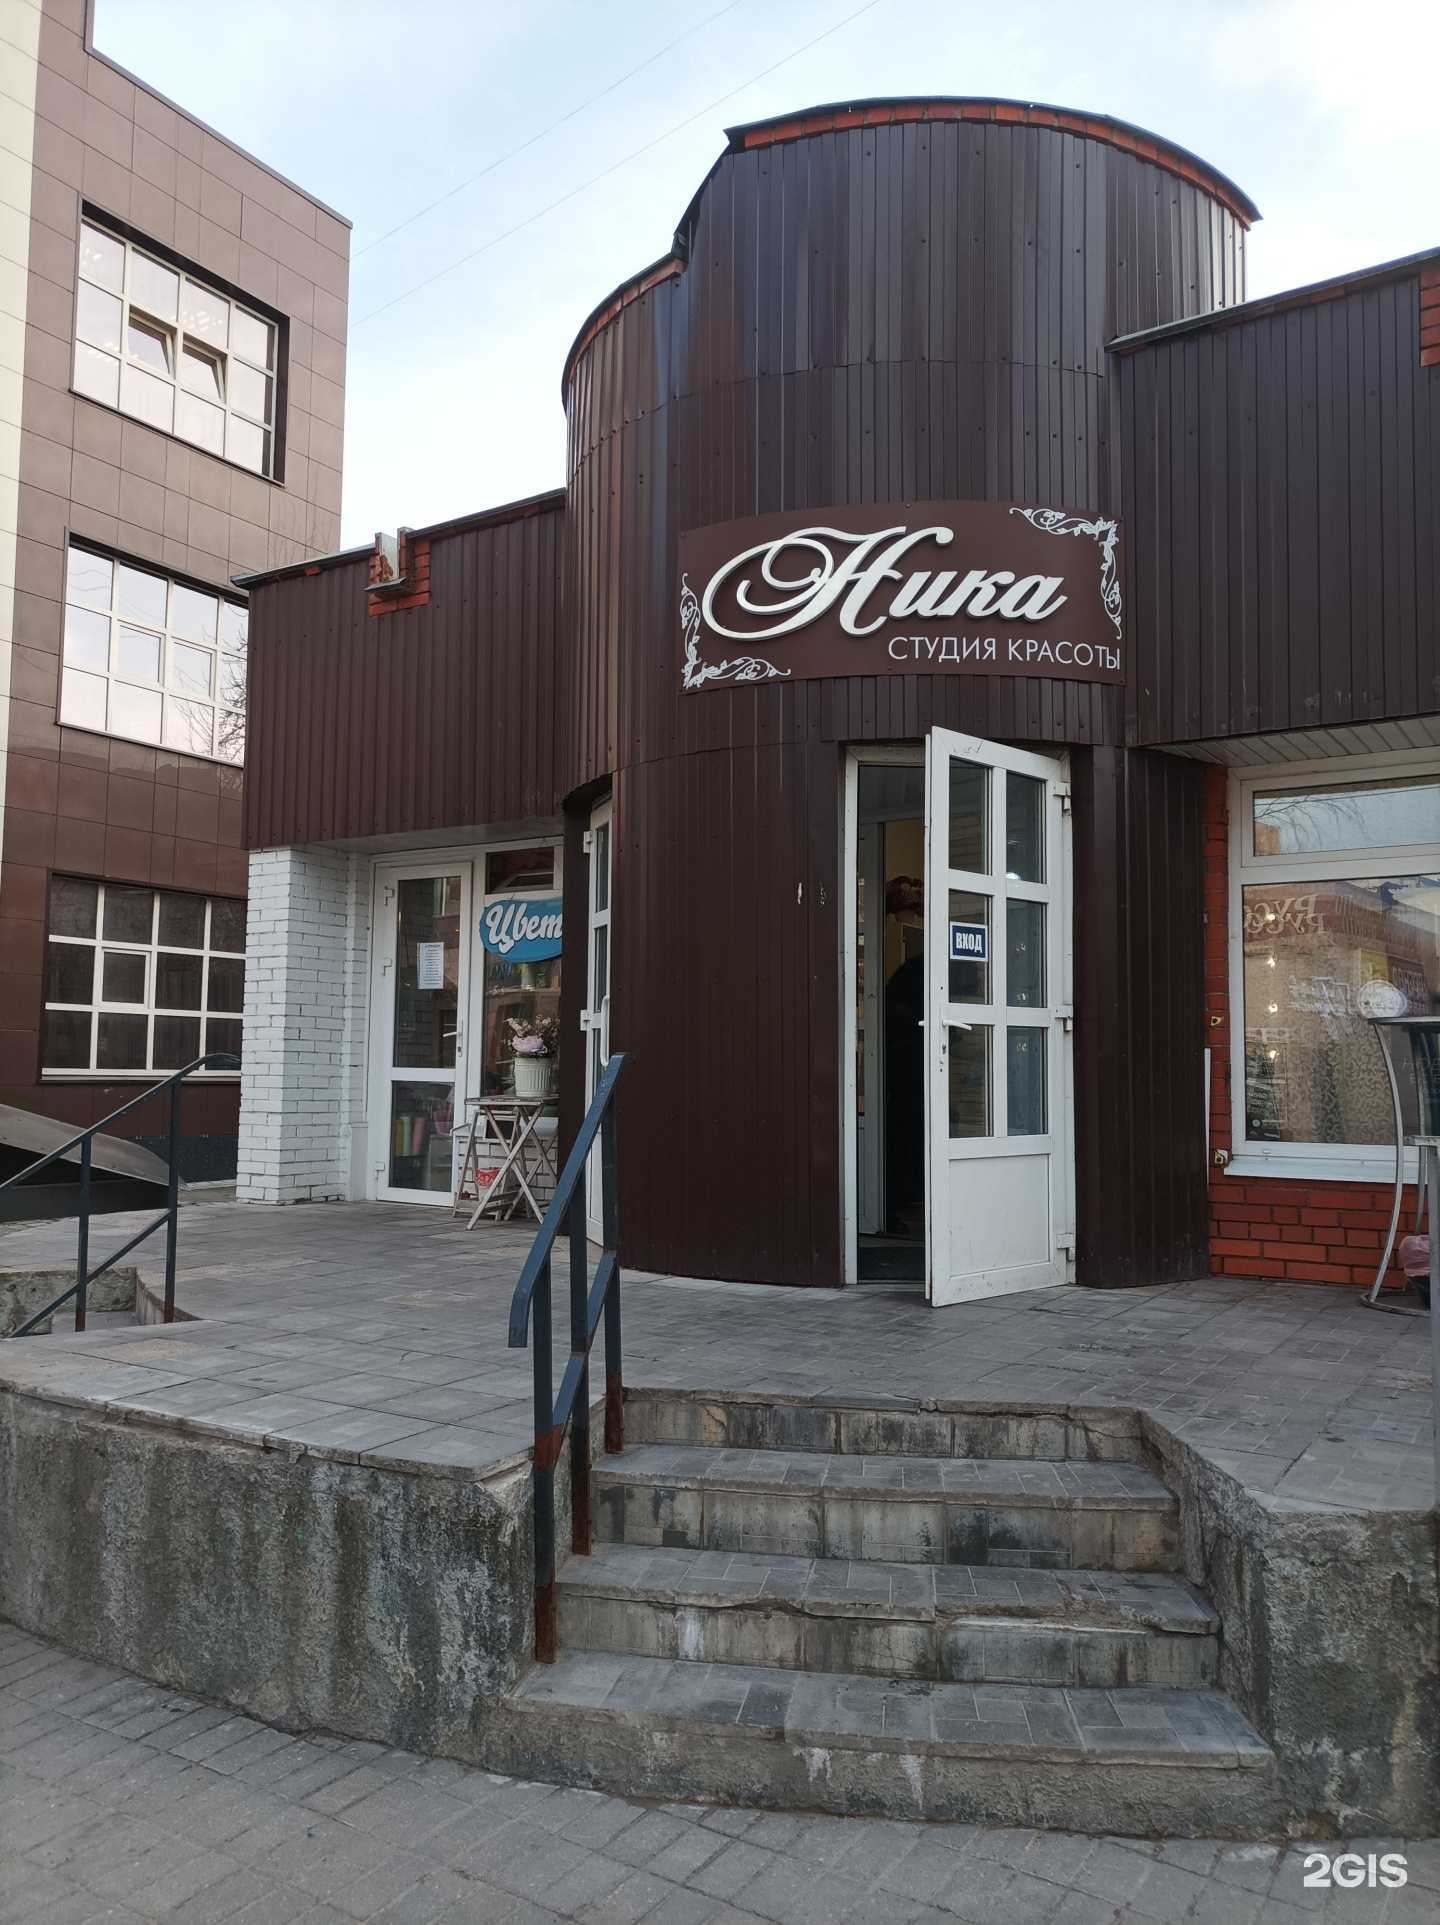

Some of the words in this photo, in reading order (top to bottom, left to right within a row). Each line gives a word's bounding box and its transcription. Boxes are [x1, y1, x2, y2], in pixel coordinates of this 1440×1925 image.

[702, 526, 1068, 641] Ника
[888, 636, 997, 663] СТУДИЯ
[1007, 638, 1121, 670] КРАСОТЫ
[955, 932, 983, 953] ВХОД
